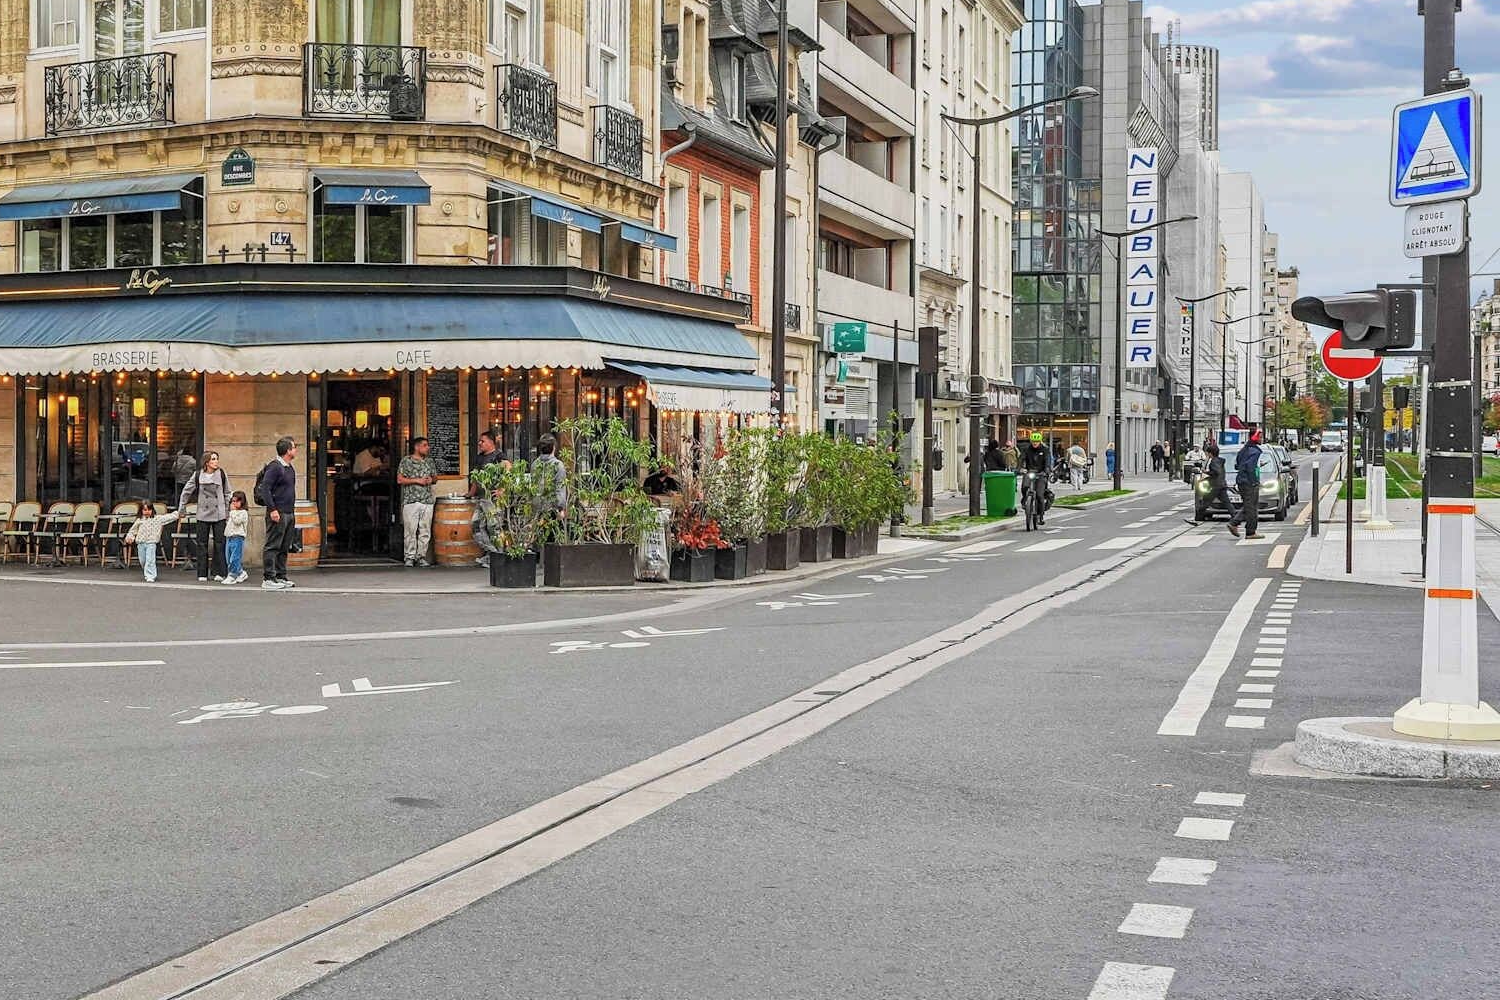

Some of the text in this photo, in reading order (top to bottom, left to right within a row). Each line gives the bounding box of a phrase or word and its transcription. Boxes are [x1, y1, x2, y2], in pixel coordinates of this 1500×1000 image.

[1419, 212, 1444, 221] ROUGE
[1411, 225, 1452, 236] CLIGNOTANT
[272, 232, 290, 245] 147
[1406, 238, 1457, 250] ARRÊT ABSOLU
[1130, 153, 1155, 362] NEUBAUER
[92, 350, 159, 366] BRASSERIE
[396, 350, 432, 365] CAFE
